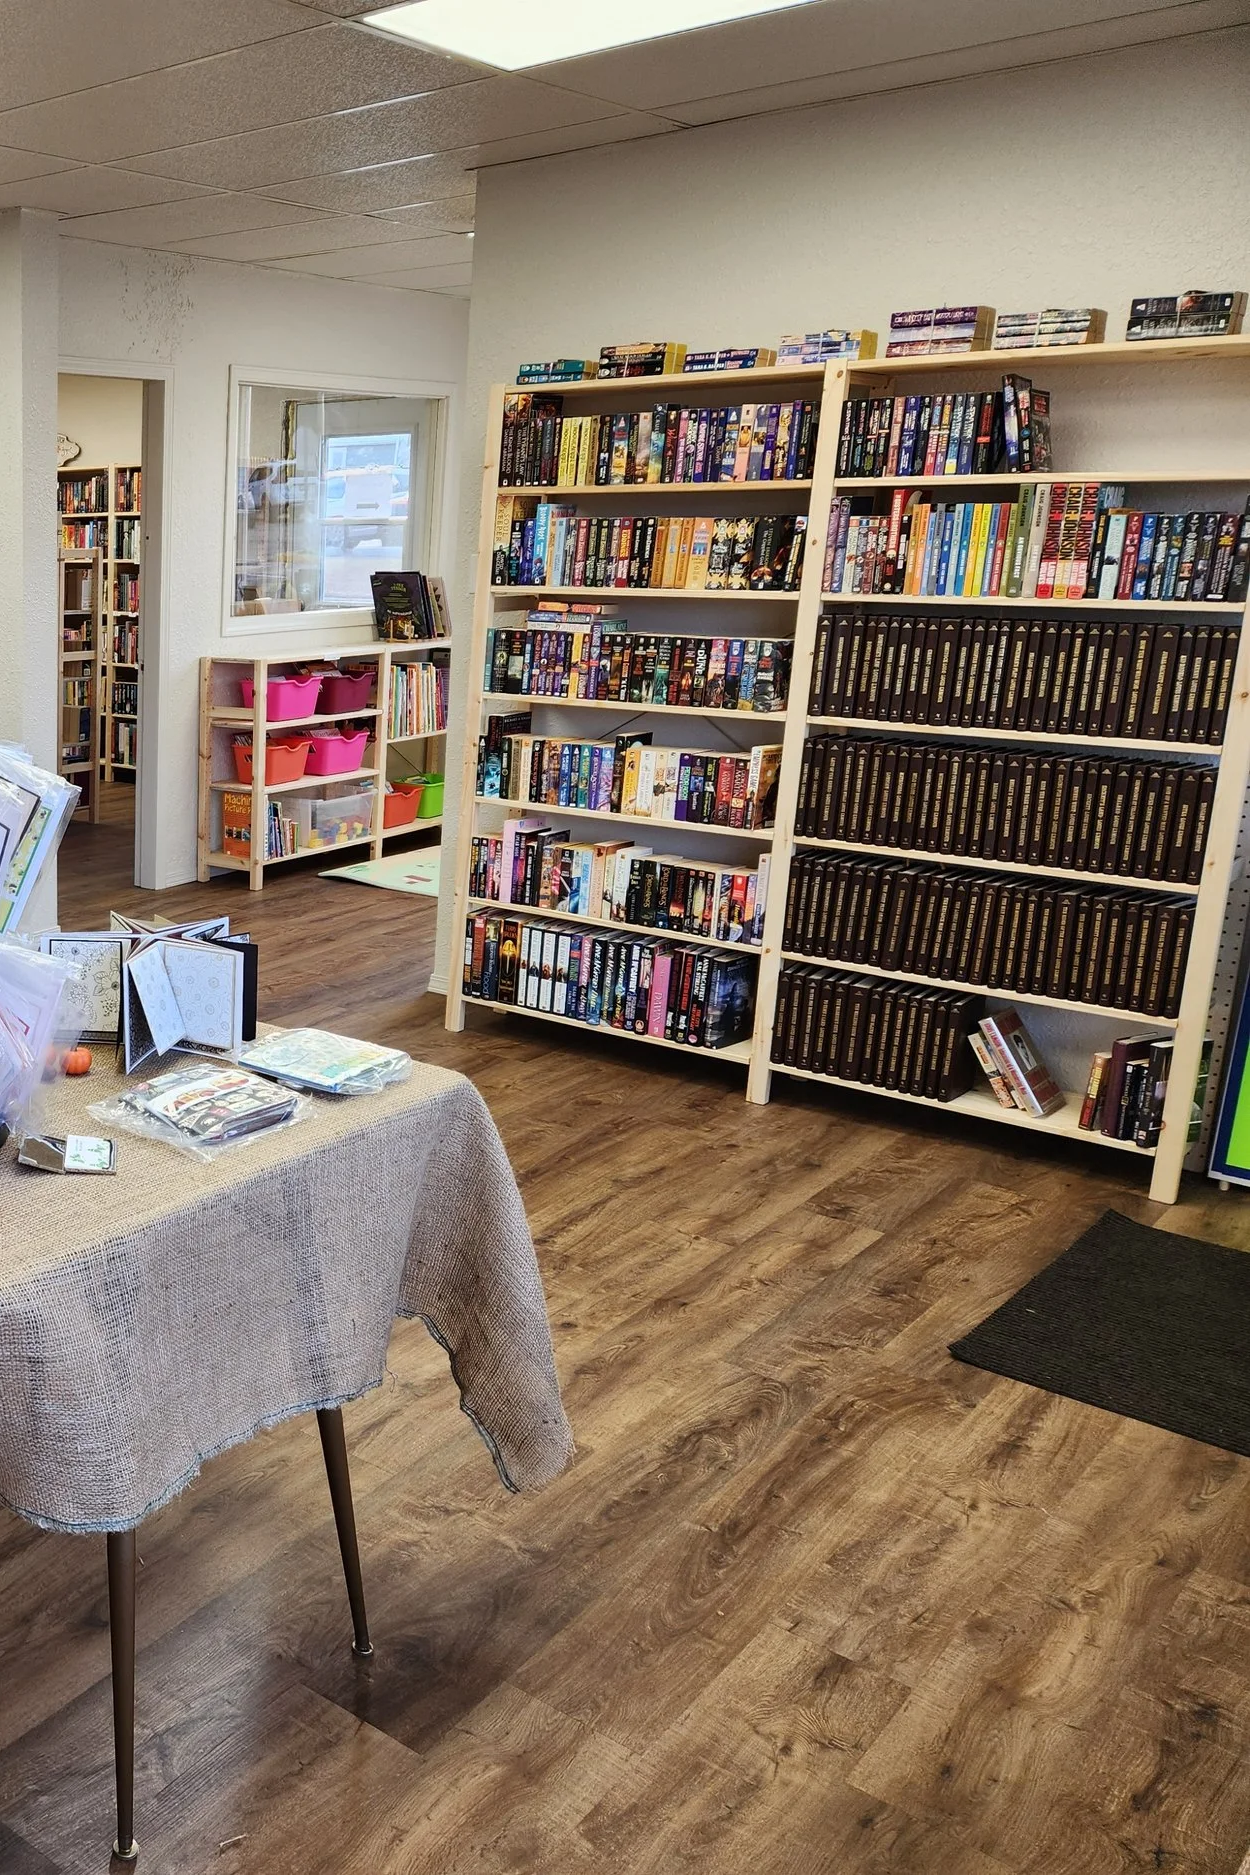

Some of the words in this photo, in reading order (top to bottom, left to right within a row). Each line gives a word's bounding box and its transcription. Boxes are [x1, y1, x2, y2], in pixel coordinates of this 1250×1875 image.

[1050, 487, 1067, 514] CRAIG
[1066, 487, 1082, 514] CRAIG
[1081, 487, 1099, 514] CRAIG
[1042, 516, 1062, 560] JOHNSON
[1058, 516, 1079, 561] JOHNSON
[1074, 516, 1094, 561] JOHNSON
